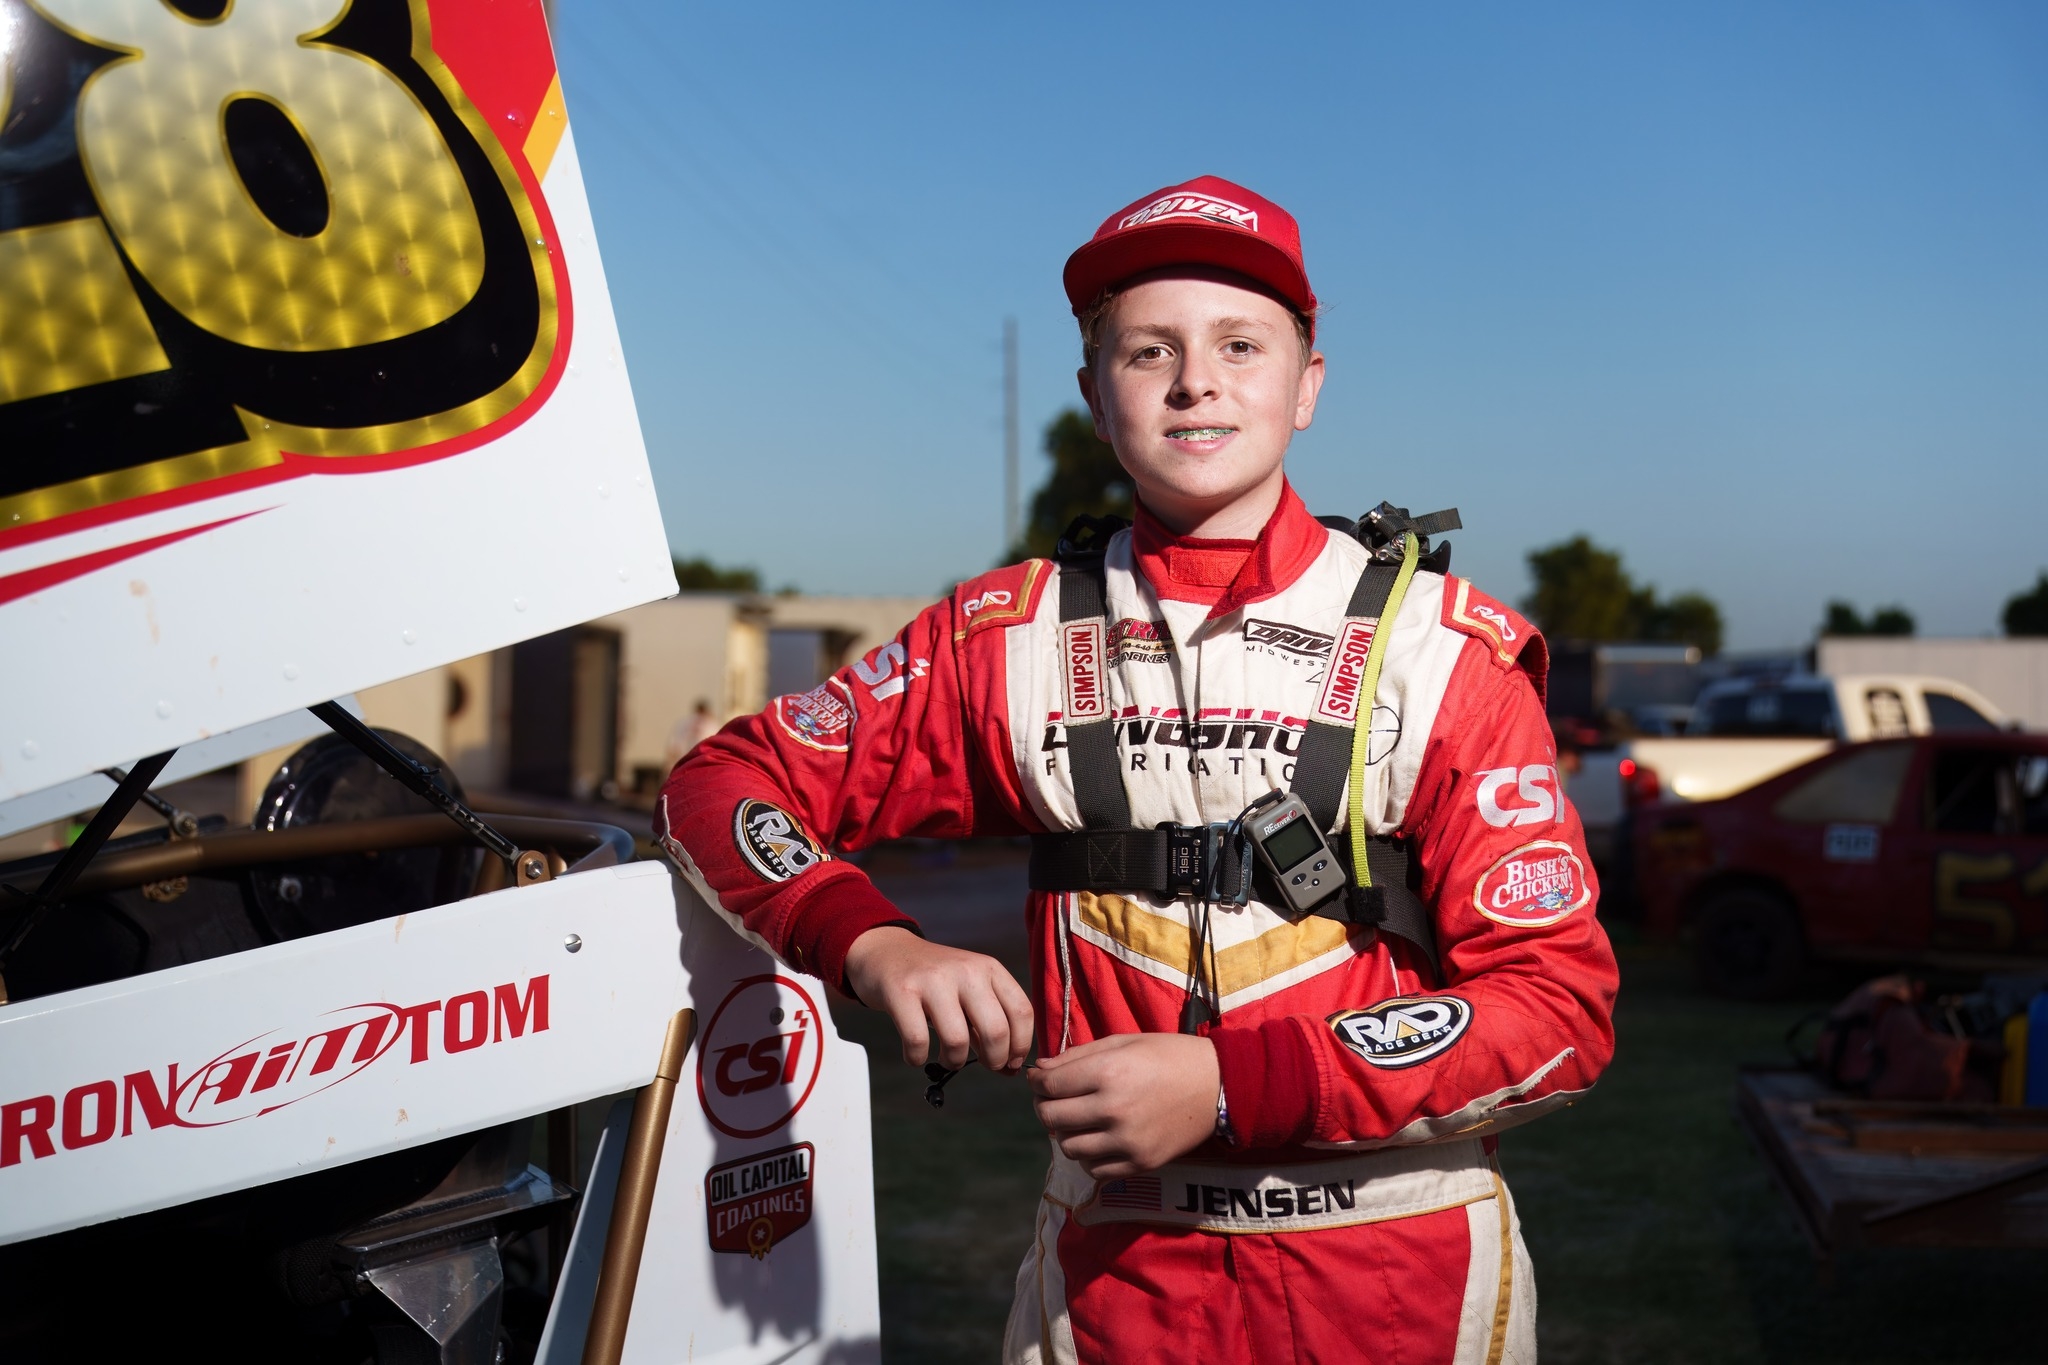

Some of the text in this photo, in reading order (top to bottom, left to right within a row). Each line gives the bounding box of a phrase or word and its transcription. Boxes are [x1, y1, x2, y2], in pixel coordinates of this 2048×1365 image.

[962, 590, 1012, 617] RAD
[1472, 604, 1517, 642] RAD
[1249, 623, 1334, 652] DRIV
[1071, 630, 1097, 711] SIMPSON
[1327, 628, 1374, 715] SIMPSON
[745, 822, 769, 850] RACE
[754, 810, 820, 875] RAD
[1316, 862, 1325, 870] 2
[400, 973, 551, 1065] TOM
[1340, 1002, 1452, 1047] RAD
[1363, 1024, 1453, 1054] RACE GEAR
[711, 1152, 808, 1203] OIL CAPITAL
[1174, 1179, 1356, 1218] JENSEN
[715, 1188, 806, 1239] COATINGS
